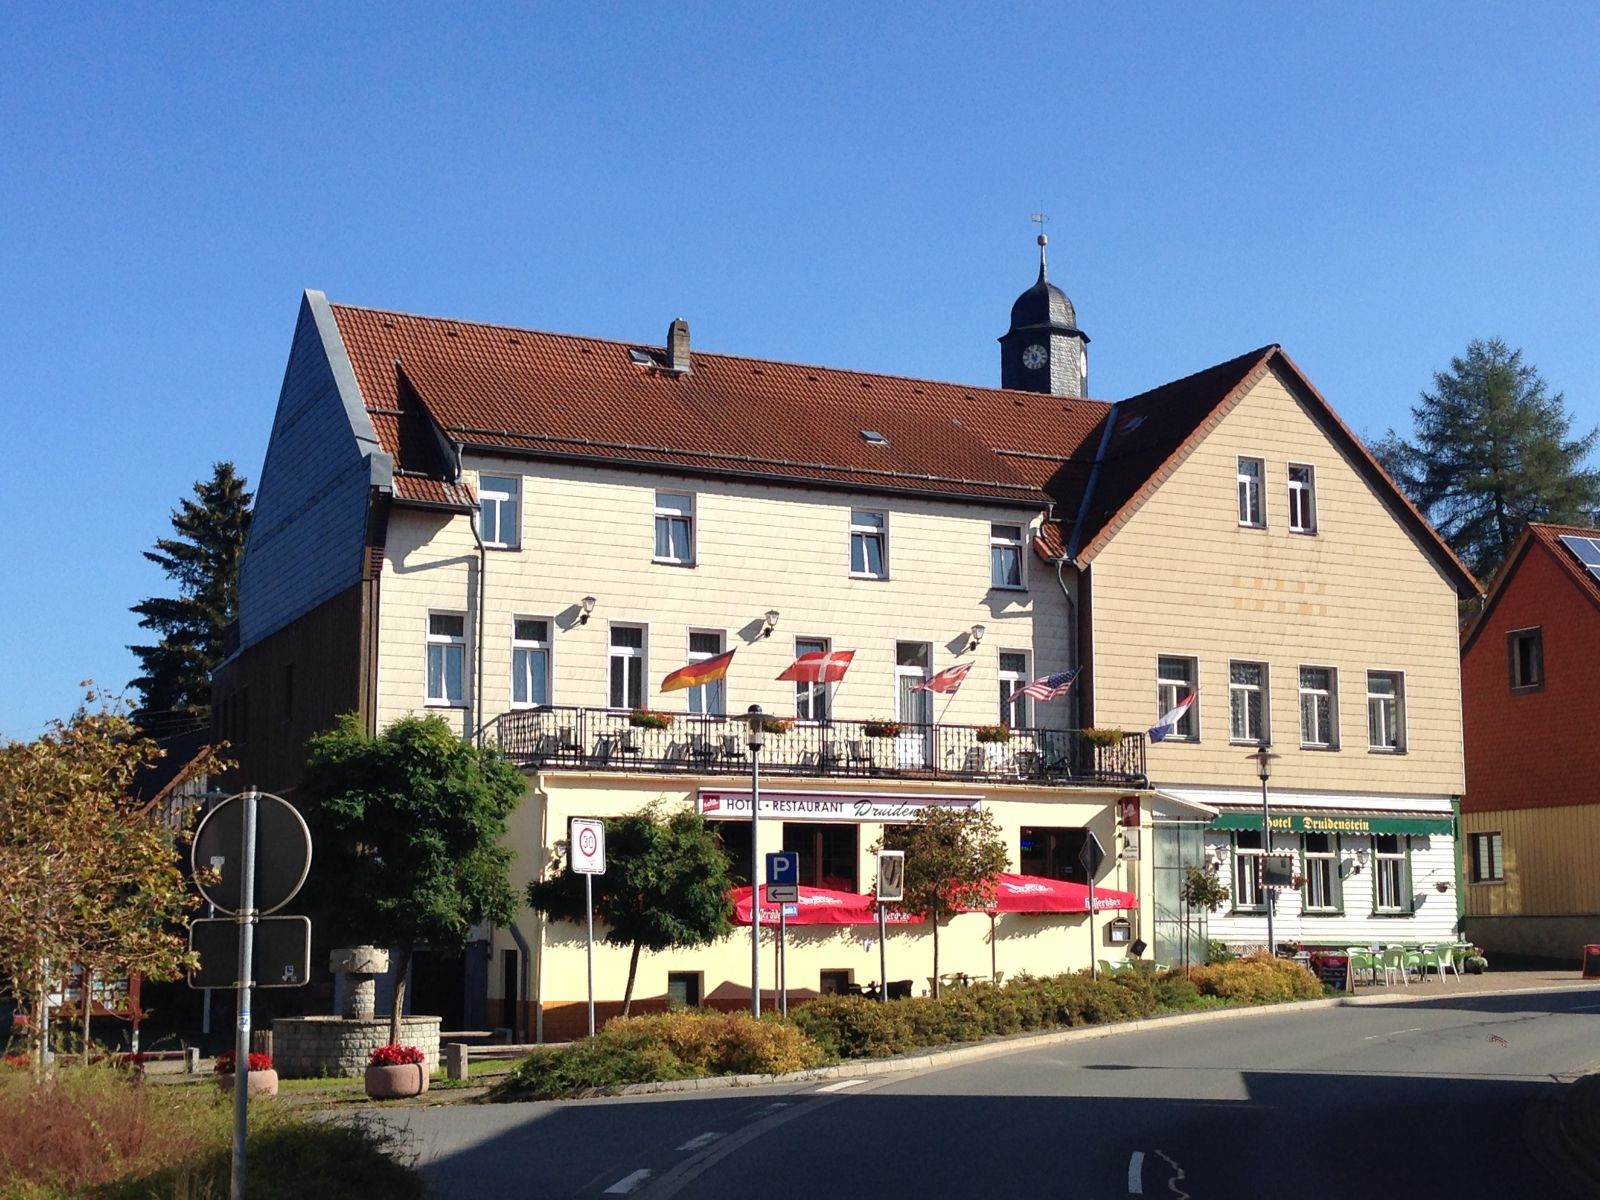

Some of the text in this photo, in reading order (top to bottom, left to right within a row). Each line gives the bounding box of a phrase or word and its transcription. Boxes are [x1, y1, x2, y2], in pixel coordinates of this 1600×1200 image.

[772, 800, 844, 813] RESTAURANT
[1303, 816, 1370, 831] Druidenstein
[583, 835, 593, 849] 30
[773, 857, 790, 881] P
